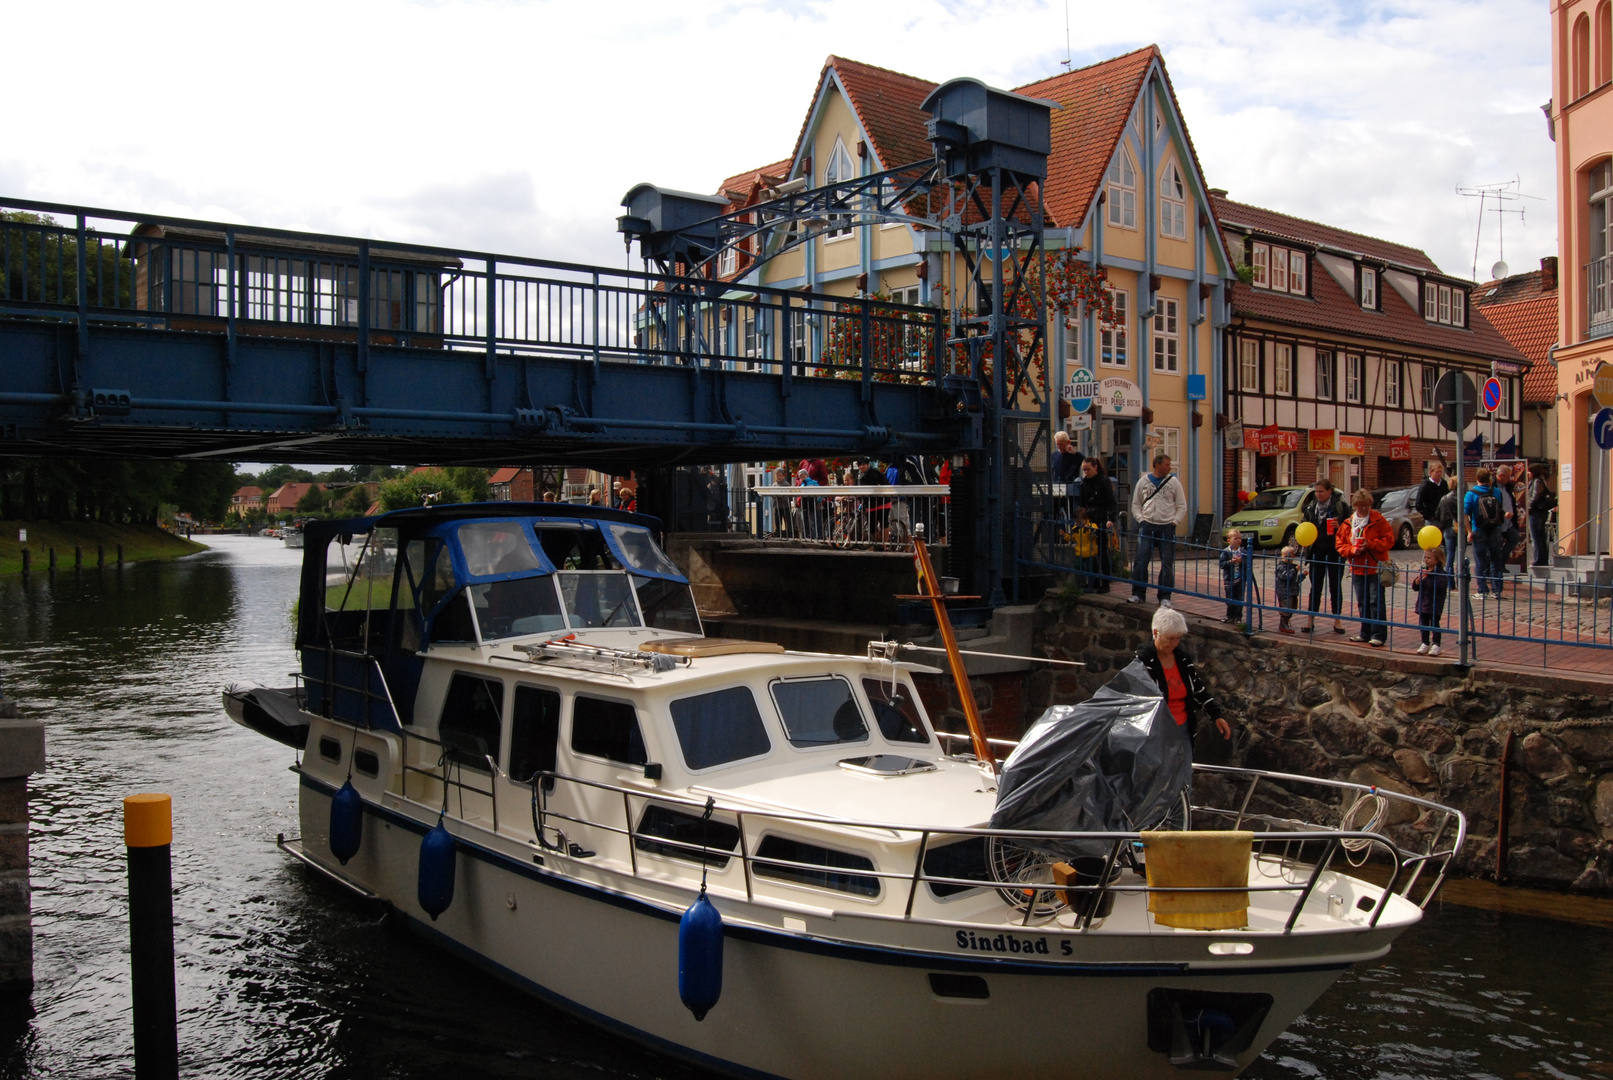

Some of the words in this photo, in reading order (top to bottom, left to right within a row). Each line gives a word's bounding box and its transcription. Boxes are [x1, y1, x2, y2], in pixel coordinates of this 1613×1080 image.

[1064, 383, 1099, 398] PLAWE
[1111, 397, 1126, 406] PLAWE
[1126, 398, 1141, 407] BISTRO
[1260, 441, 1279, 455] Eis
[1312, 438, 1331, 450] Eis
[1391, 446, 1409, 458] Eis
[956, 930, 1050, 955] Sindbad
[1060, 939, 1074, 956] 5
